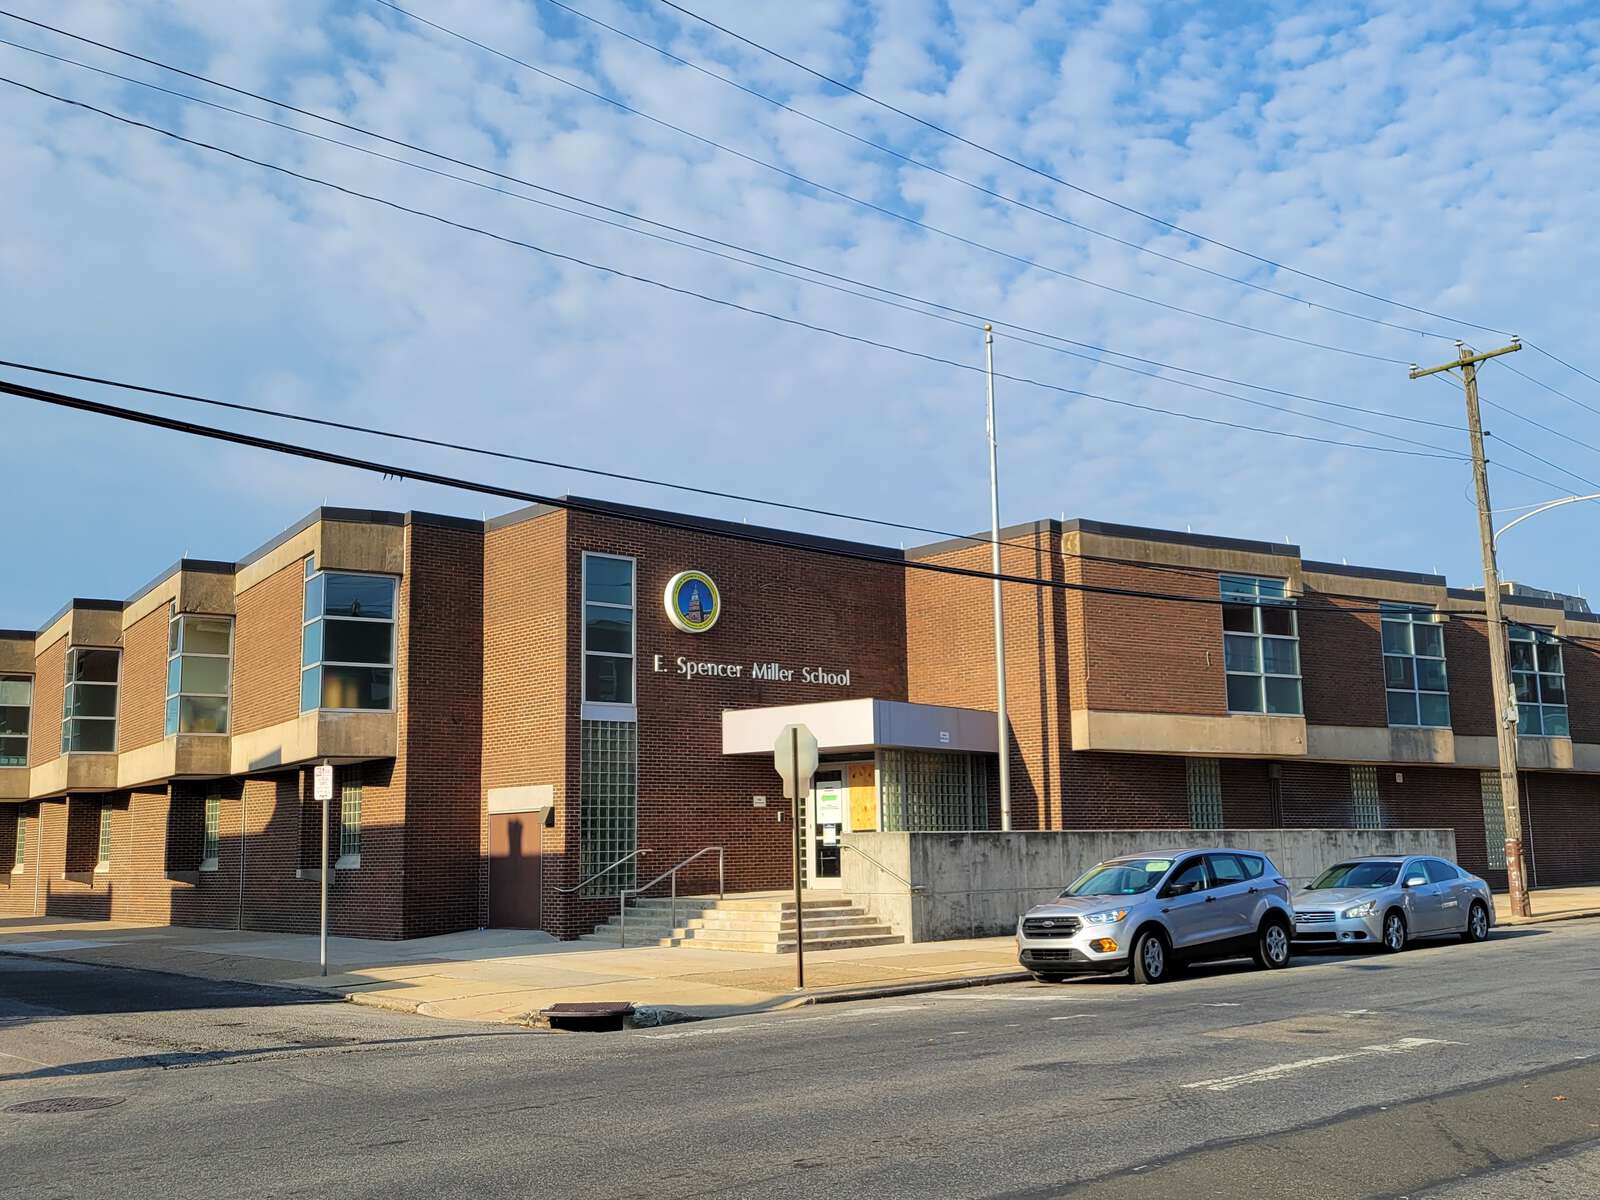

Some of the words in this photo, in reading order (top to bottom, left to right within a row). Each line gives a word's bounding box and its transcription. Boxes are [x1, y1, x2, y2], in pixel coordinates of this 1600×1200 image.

[654, 654, 668, 673] E.
[676, 656, 743, 680] Spencer
[752, 662, 795, 682] Miller
[801, 666, 850, 686] School
